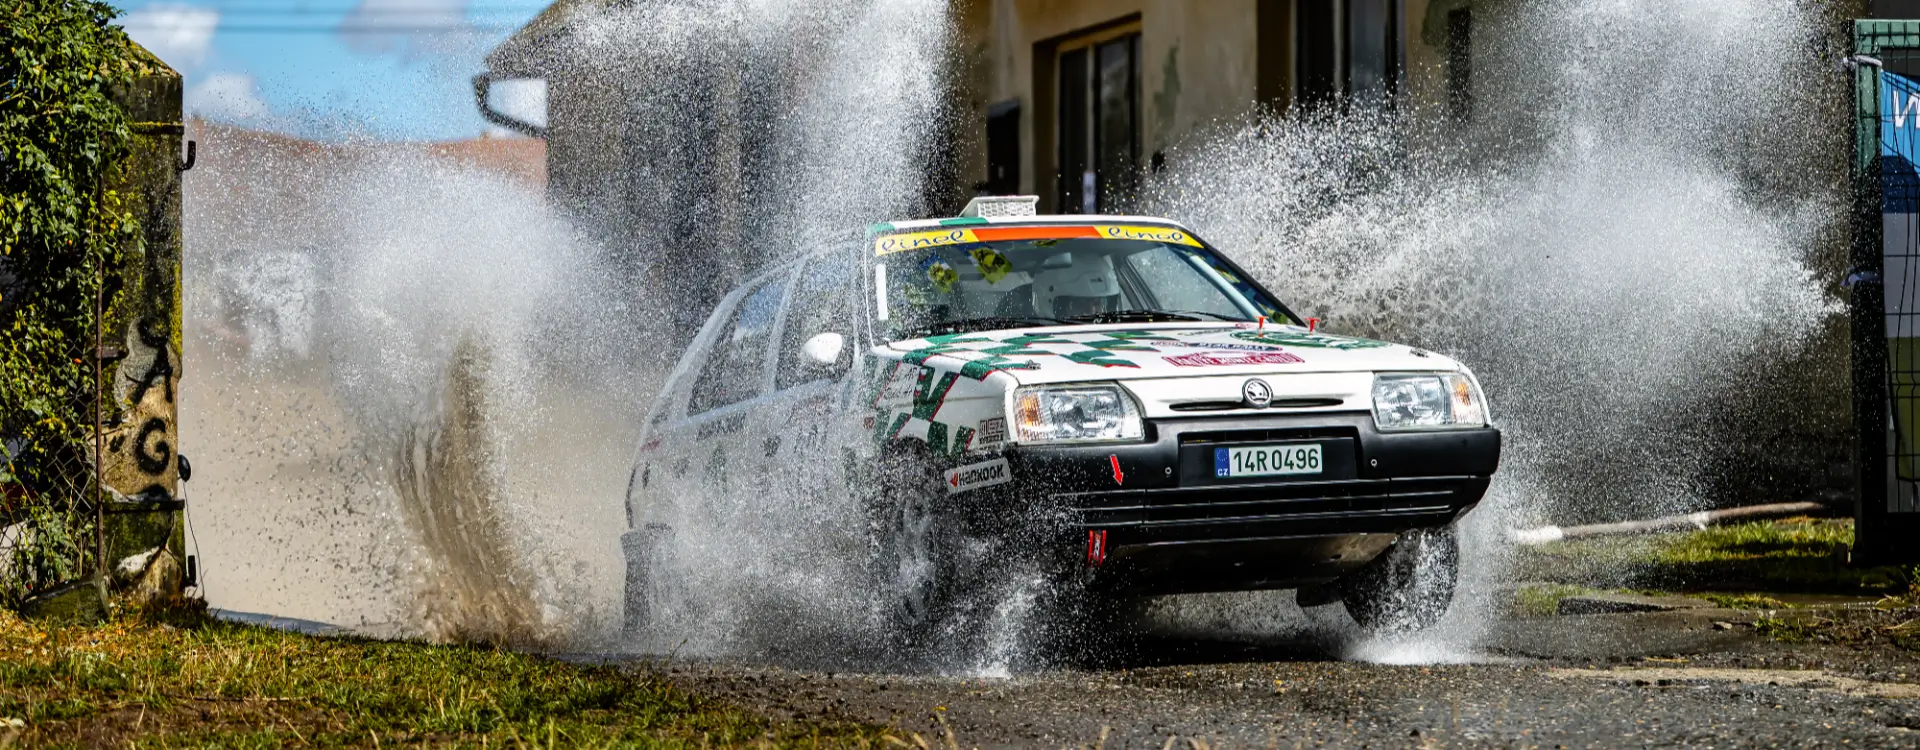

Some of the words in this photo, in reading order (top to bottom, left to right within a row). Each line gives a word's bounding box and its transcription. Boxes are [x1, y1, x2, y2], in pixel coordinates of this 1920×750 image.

[1233, 450, 1268, 473] 14R
[1271, 448, 1319, 471] 0496
[1217, 468, 1229, 477] CZ
